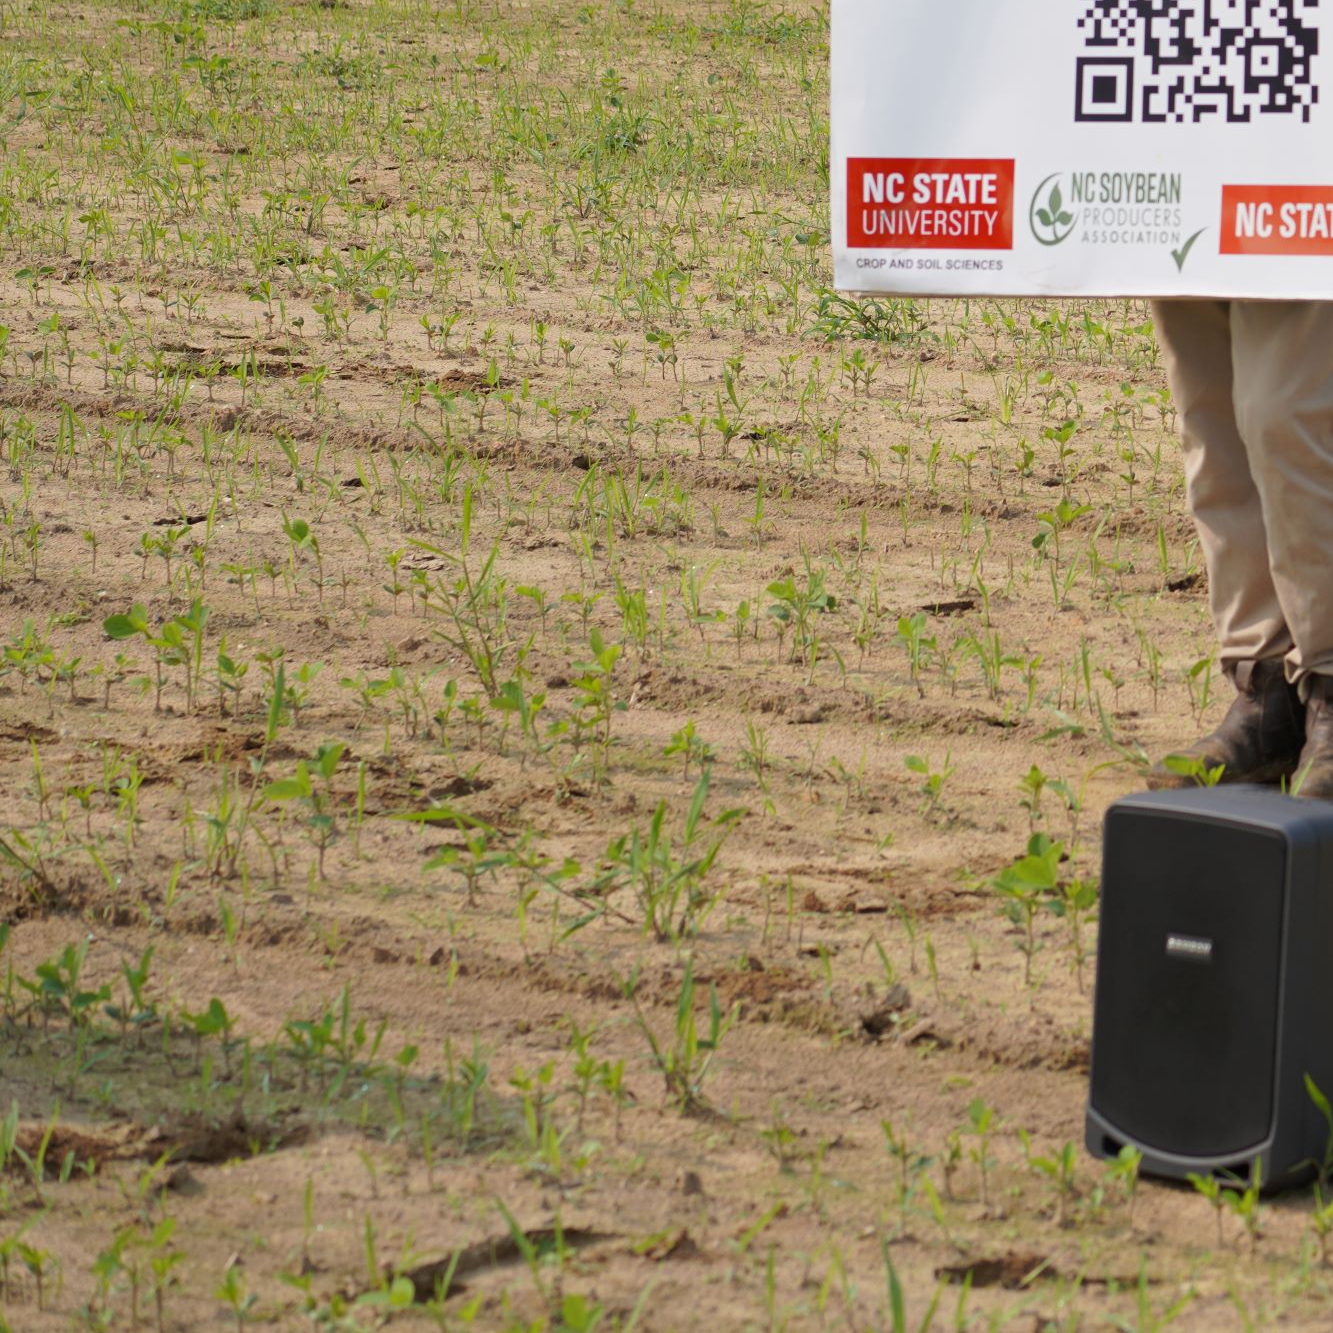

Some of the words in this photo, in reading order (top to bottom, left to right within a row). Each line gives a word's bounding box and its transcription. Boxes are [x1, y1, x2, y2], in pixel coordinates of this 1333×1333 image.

[862, 172, 905, 204] NC
[912, 172, 997, 204] STATE
[1071, 172, 1096, 203] NC
[1100, 172, 1182, 204] SOYBEAN
[862, 209, 998, 236] UNIVERSITY
[1082, 207, 1182, 227] PRODUCERS
[1235, 202, 1273, 238] NC
[1081, 230, 1181, 244] ASSOCIATION
[856, 258, 887, 270] CROP
[889, 258, 914, 270] AND
[917, 258, 943, 270] SOIL
[945, 259, 1004, 271] SCIENCES
